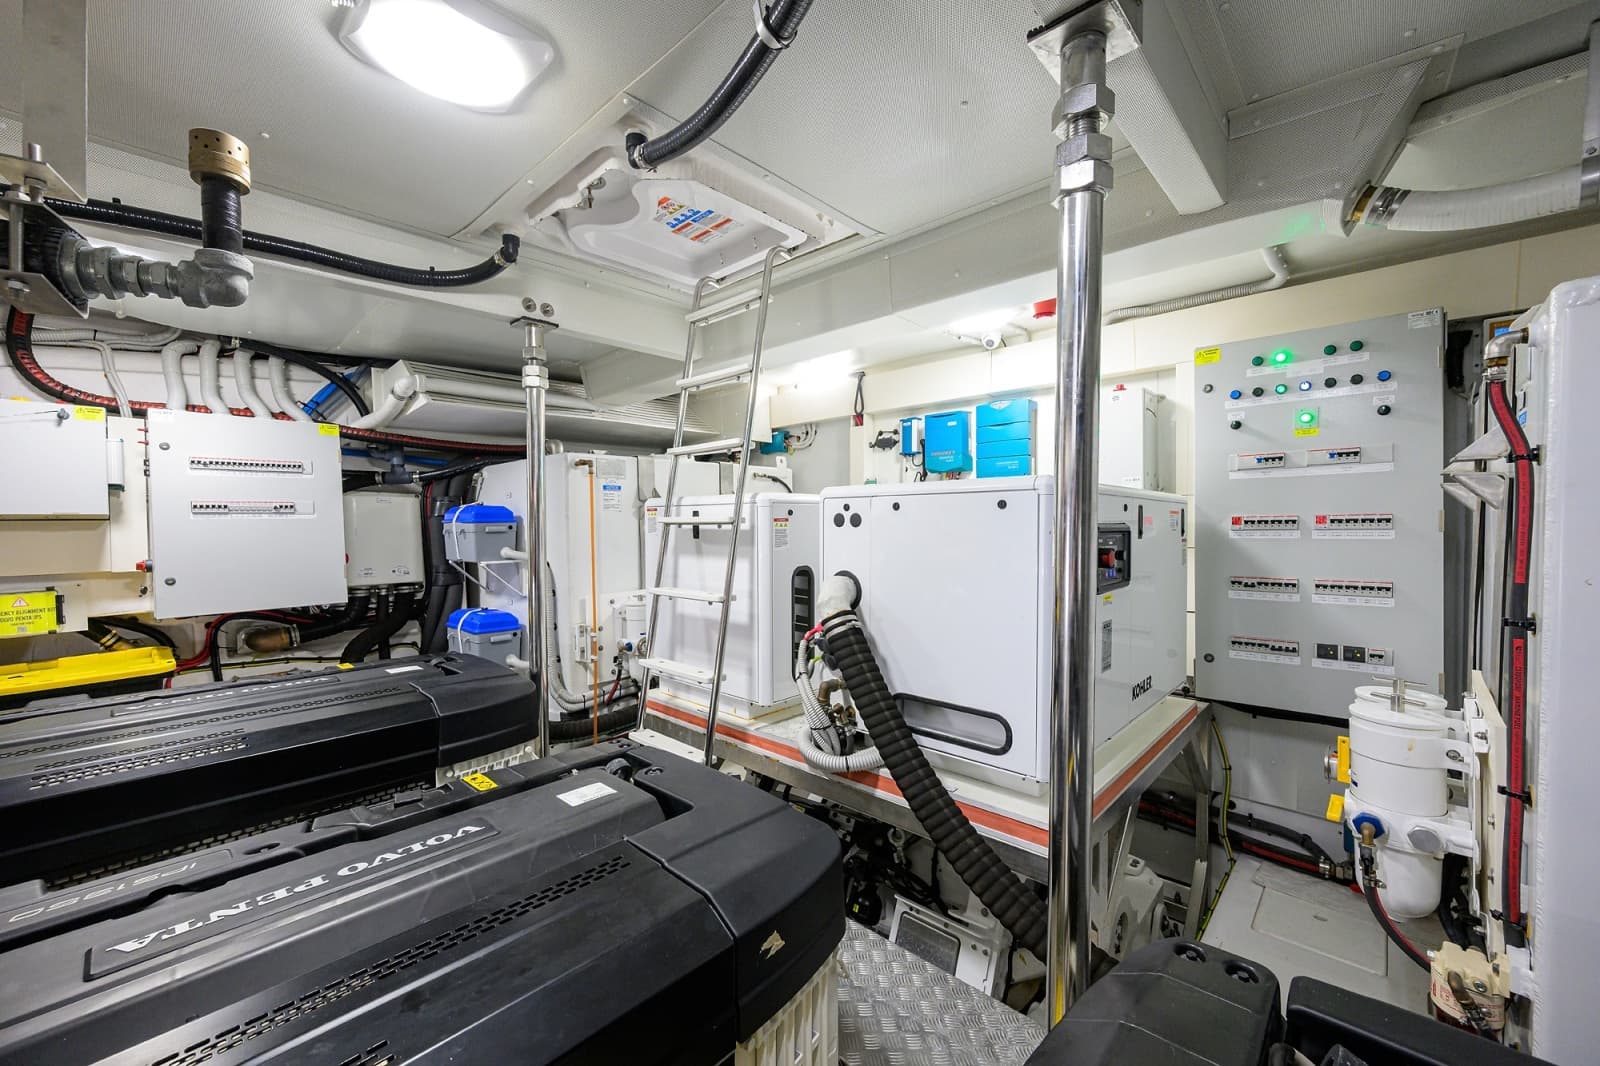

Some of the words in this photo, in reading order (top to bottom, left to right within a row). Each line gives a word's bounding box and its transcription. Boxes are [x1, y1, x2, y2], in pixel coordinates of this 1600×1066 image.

[1132, 675, 1152, 701] KOHLER
[337, 824, 486, 876] VOLVO
[106, 874, 330, 952] PENTA
